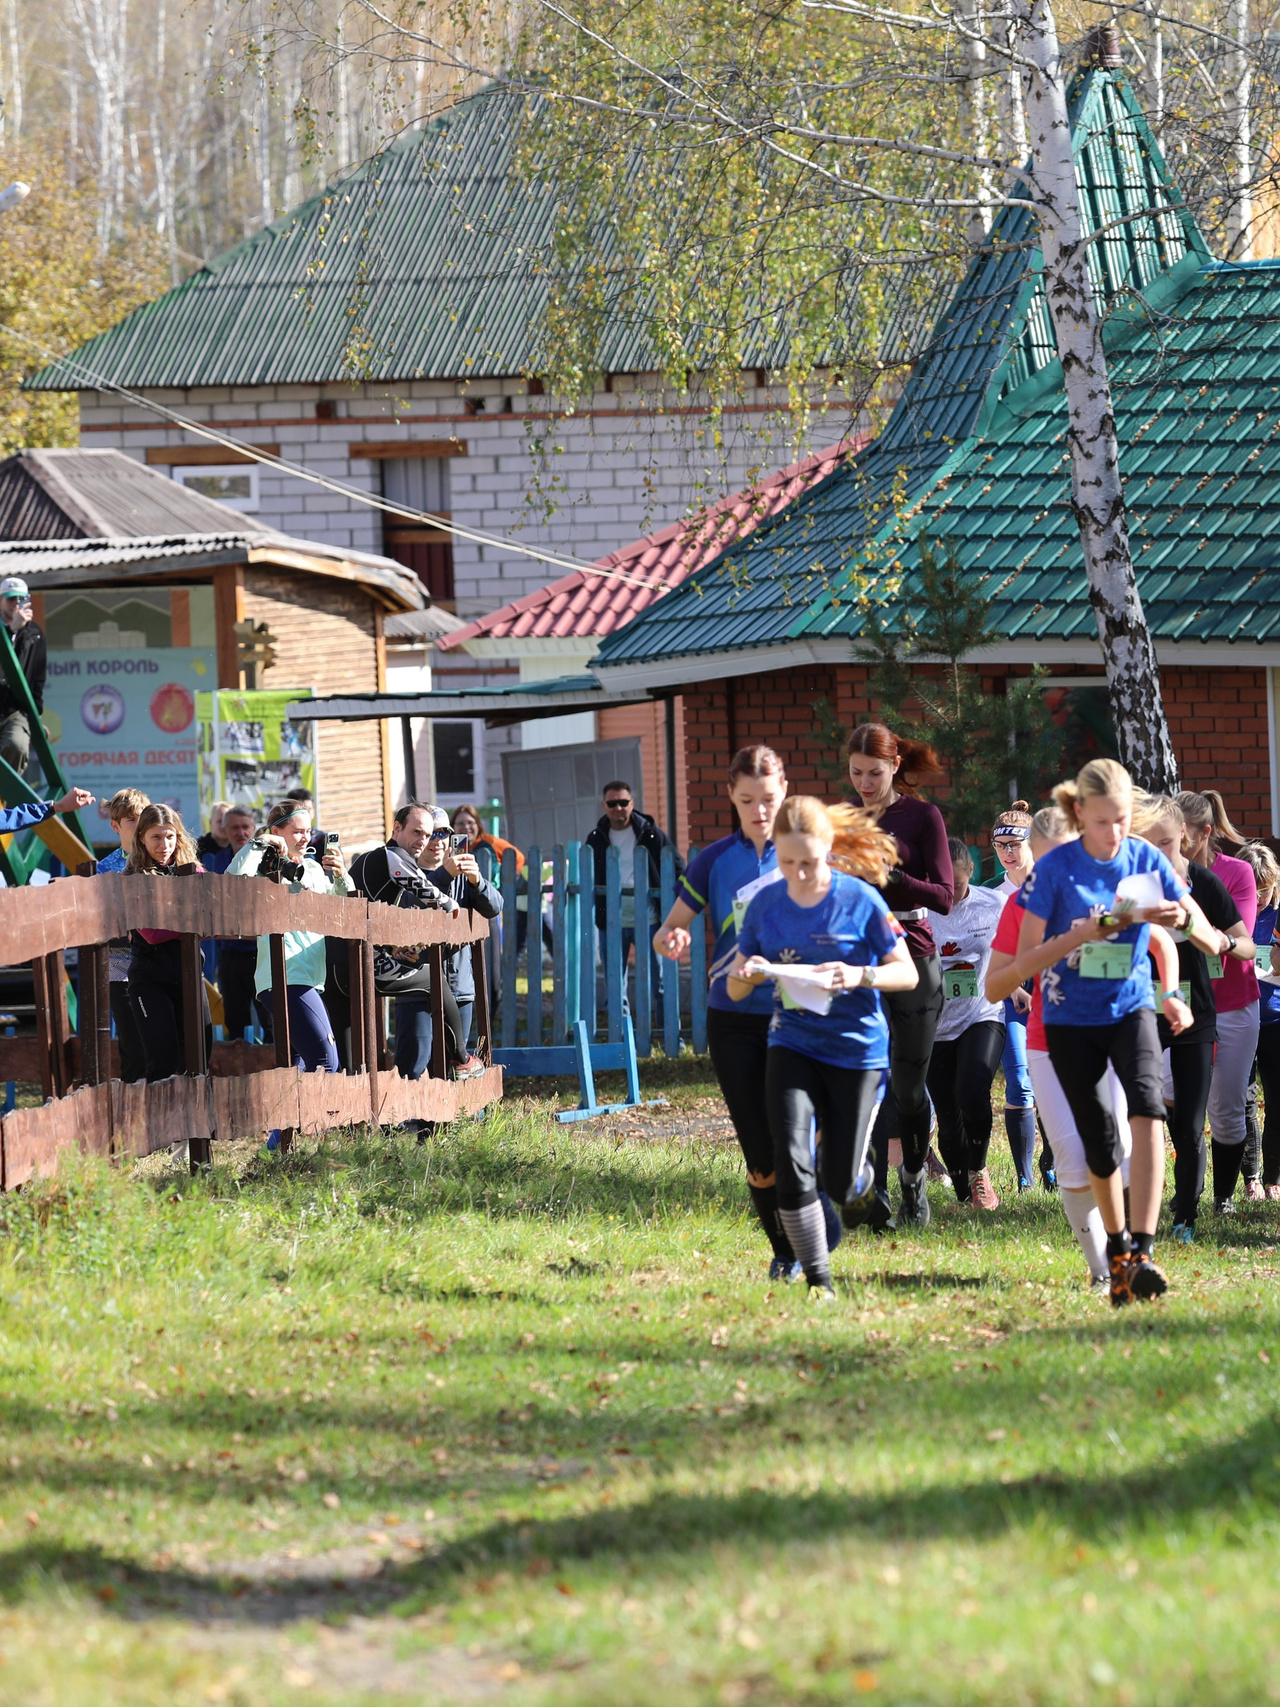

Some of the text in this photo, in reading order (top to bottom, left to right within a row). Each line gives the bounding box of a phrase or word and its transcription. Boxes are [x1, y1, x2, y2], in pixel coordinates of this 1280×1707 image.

[46, 658, 160, 676] НЫЙ КОРОЛЬ
[58, 749, 196, 767] ГОРЯЧАЯ ДЕСЯТ
[1101, 961, 1108, 979] 1
[1216, 966, 1221, 976] 1
[952, 983, 974, 997] 8 2
